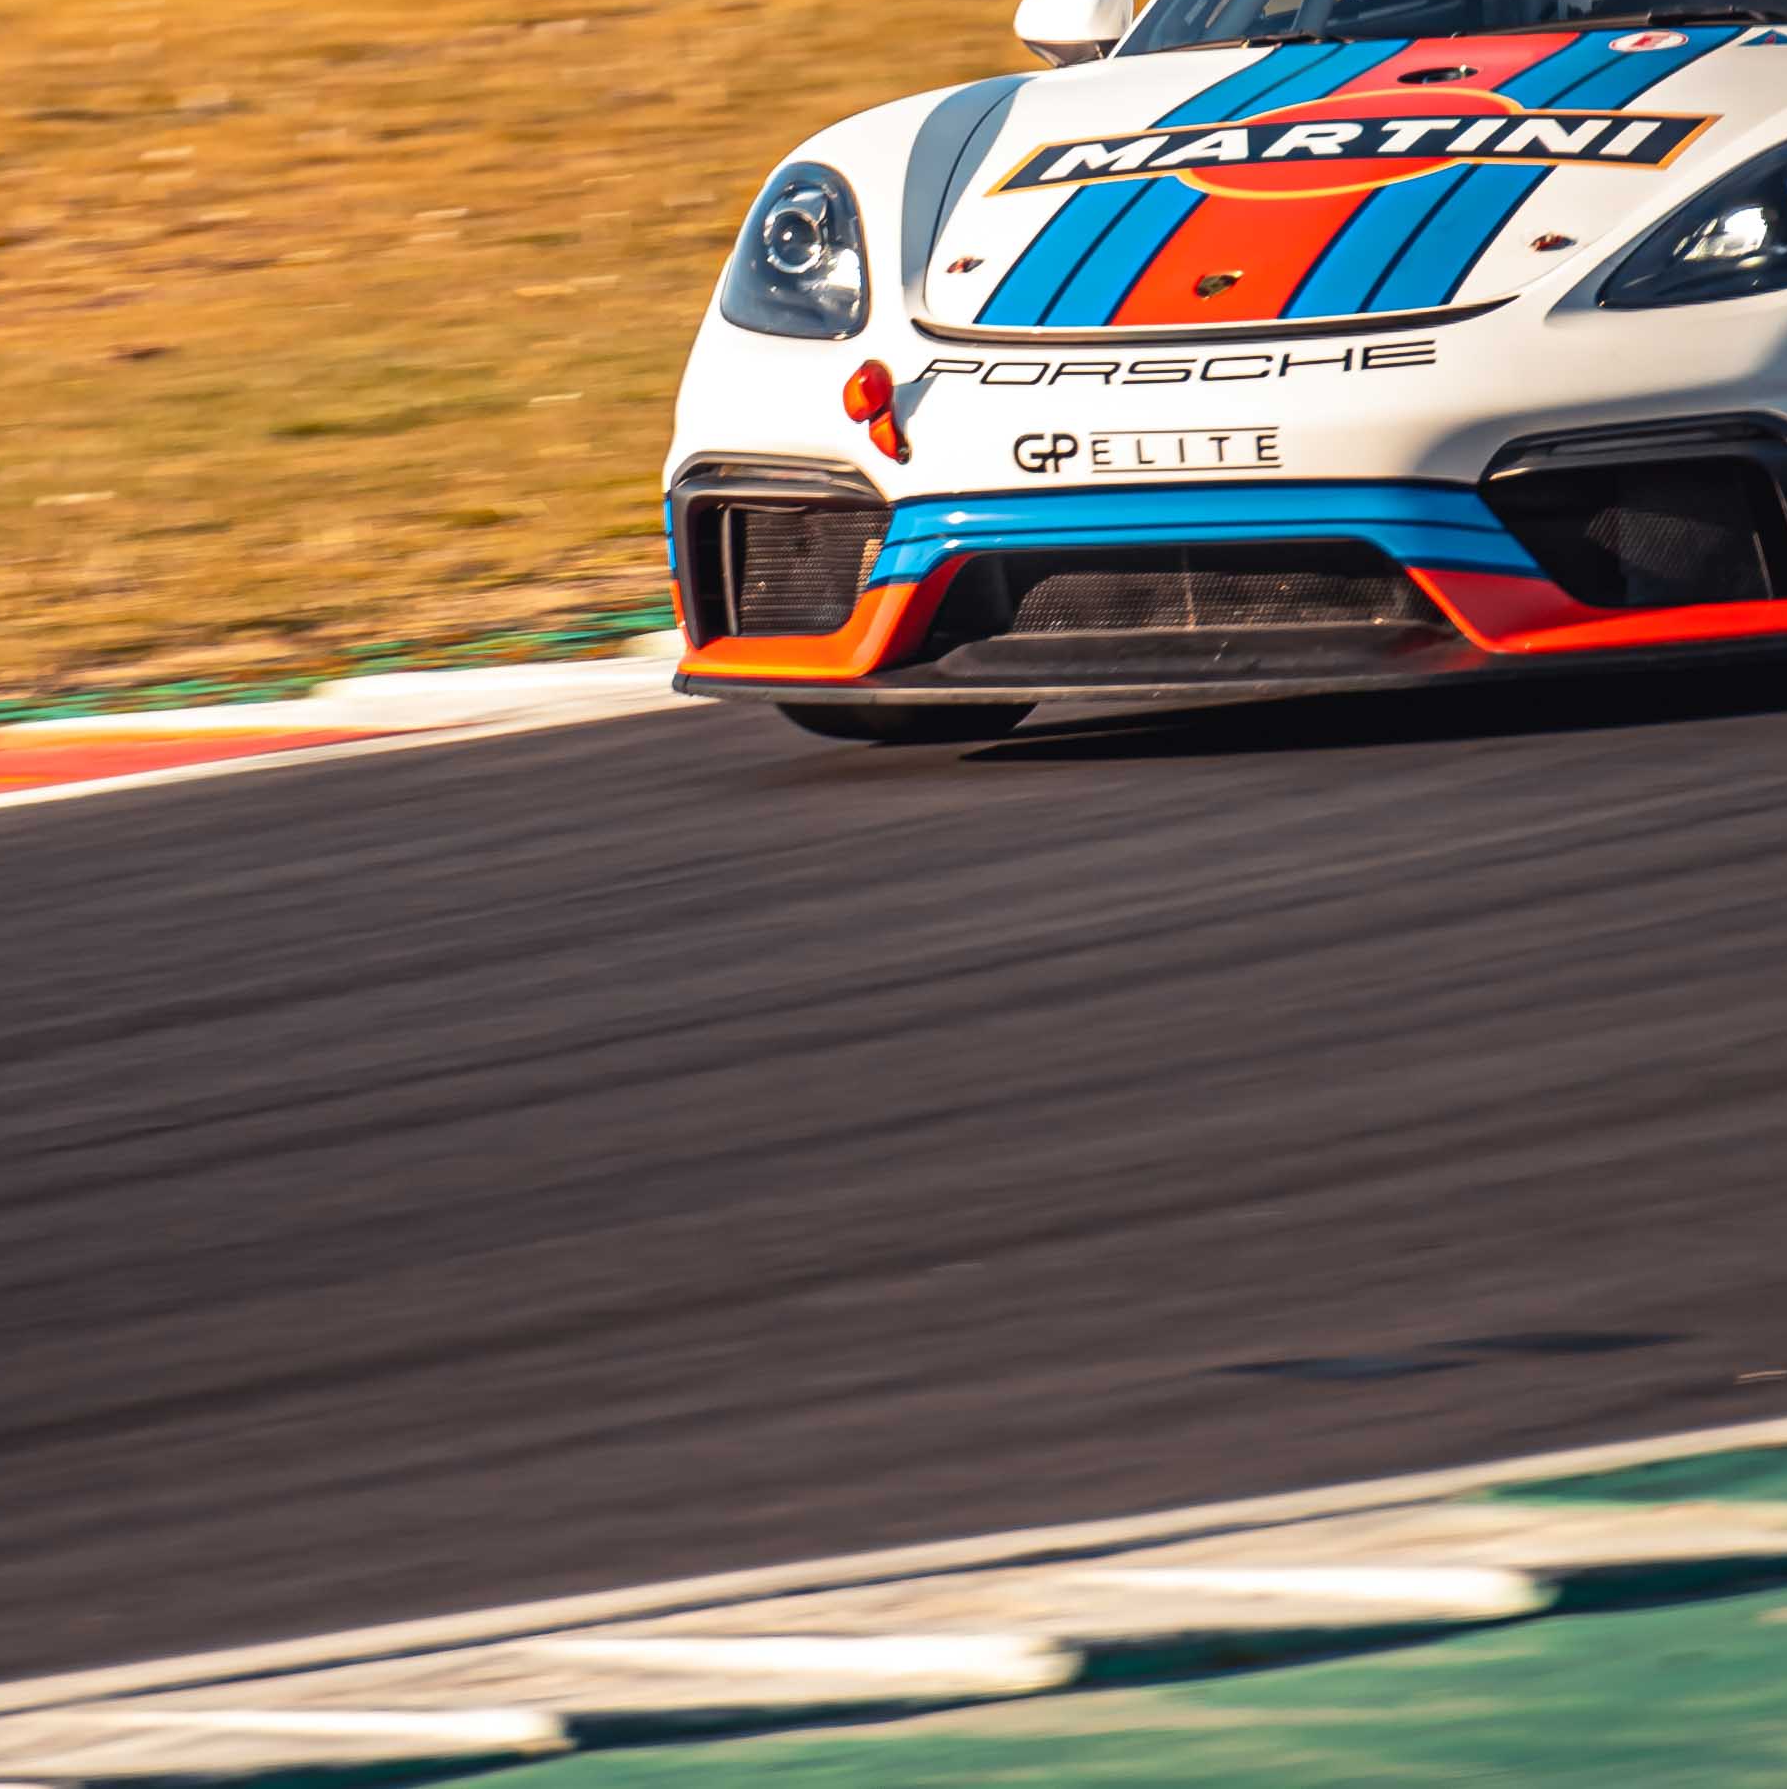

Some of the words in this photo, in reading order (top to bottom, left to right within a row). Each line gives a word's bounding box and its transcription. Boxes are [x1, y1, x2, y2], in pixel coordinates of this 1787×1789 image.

[1039, 119, 1663, 181] MARTINI
[916, 339, 1437, 385] PORSCHE
[1092, 432, 1282, 467] ELITE
